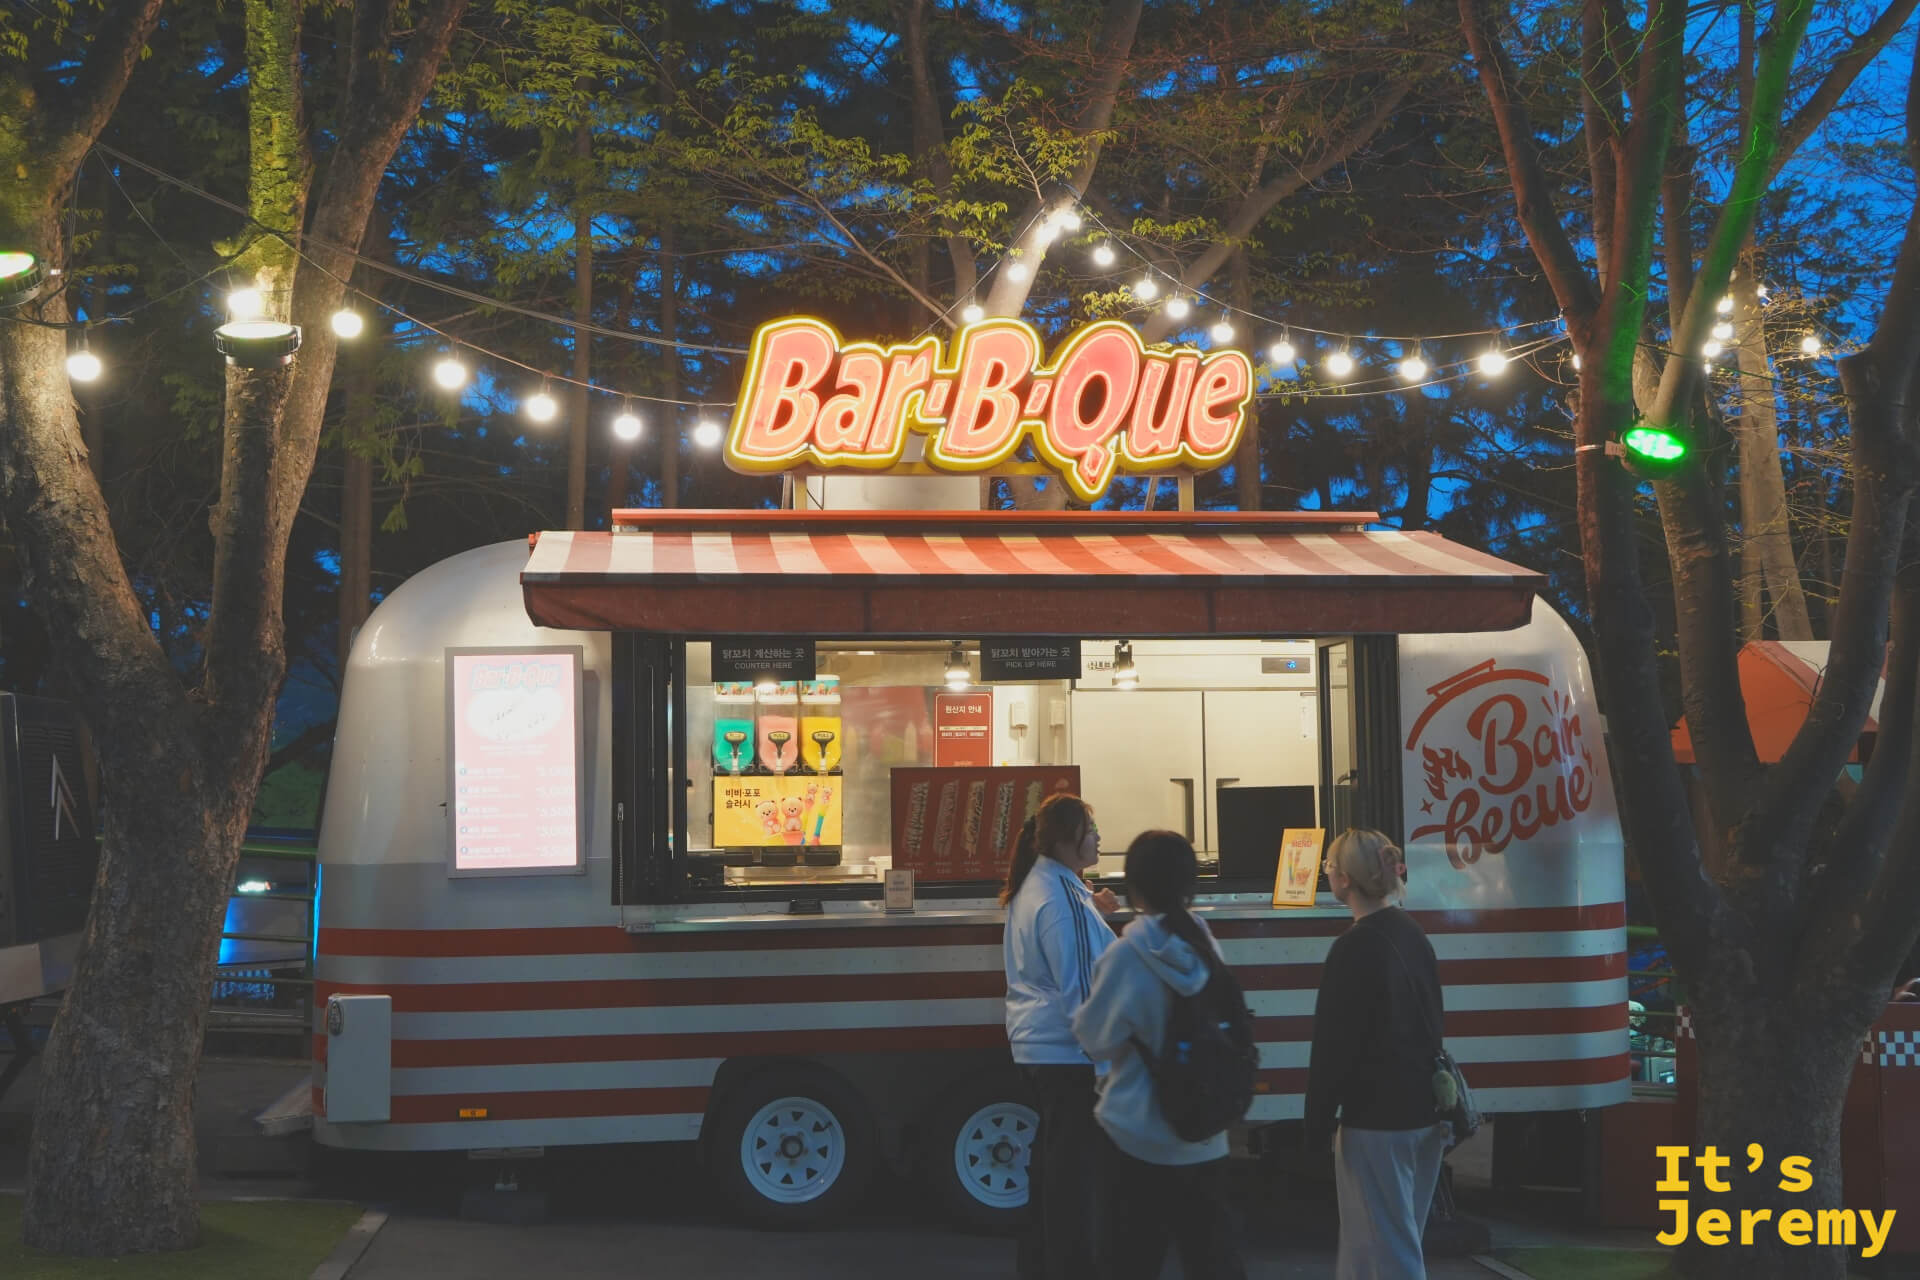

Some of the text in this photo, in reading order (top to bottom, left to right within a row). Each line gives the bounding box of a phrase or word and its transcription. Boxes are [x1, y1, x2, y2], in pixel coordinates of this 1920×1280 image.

[728, 320, 1252, 498] Bar-B-Que
[722, 647, 805, 660] 닭꼬치 계산하는 곳
[991, 646, 1071, 659] 닭꼬치 받아가는 곳
[734, 661, 793, 670] COUNTER HERE
[1005, 660, 1057, 669] PICK UP HERE
[945, 704, 982, 714] 원산지 안내
[1466, 693, 1583, 796] Bar
[725, 799, 751, 809] 슬러시
